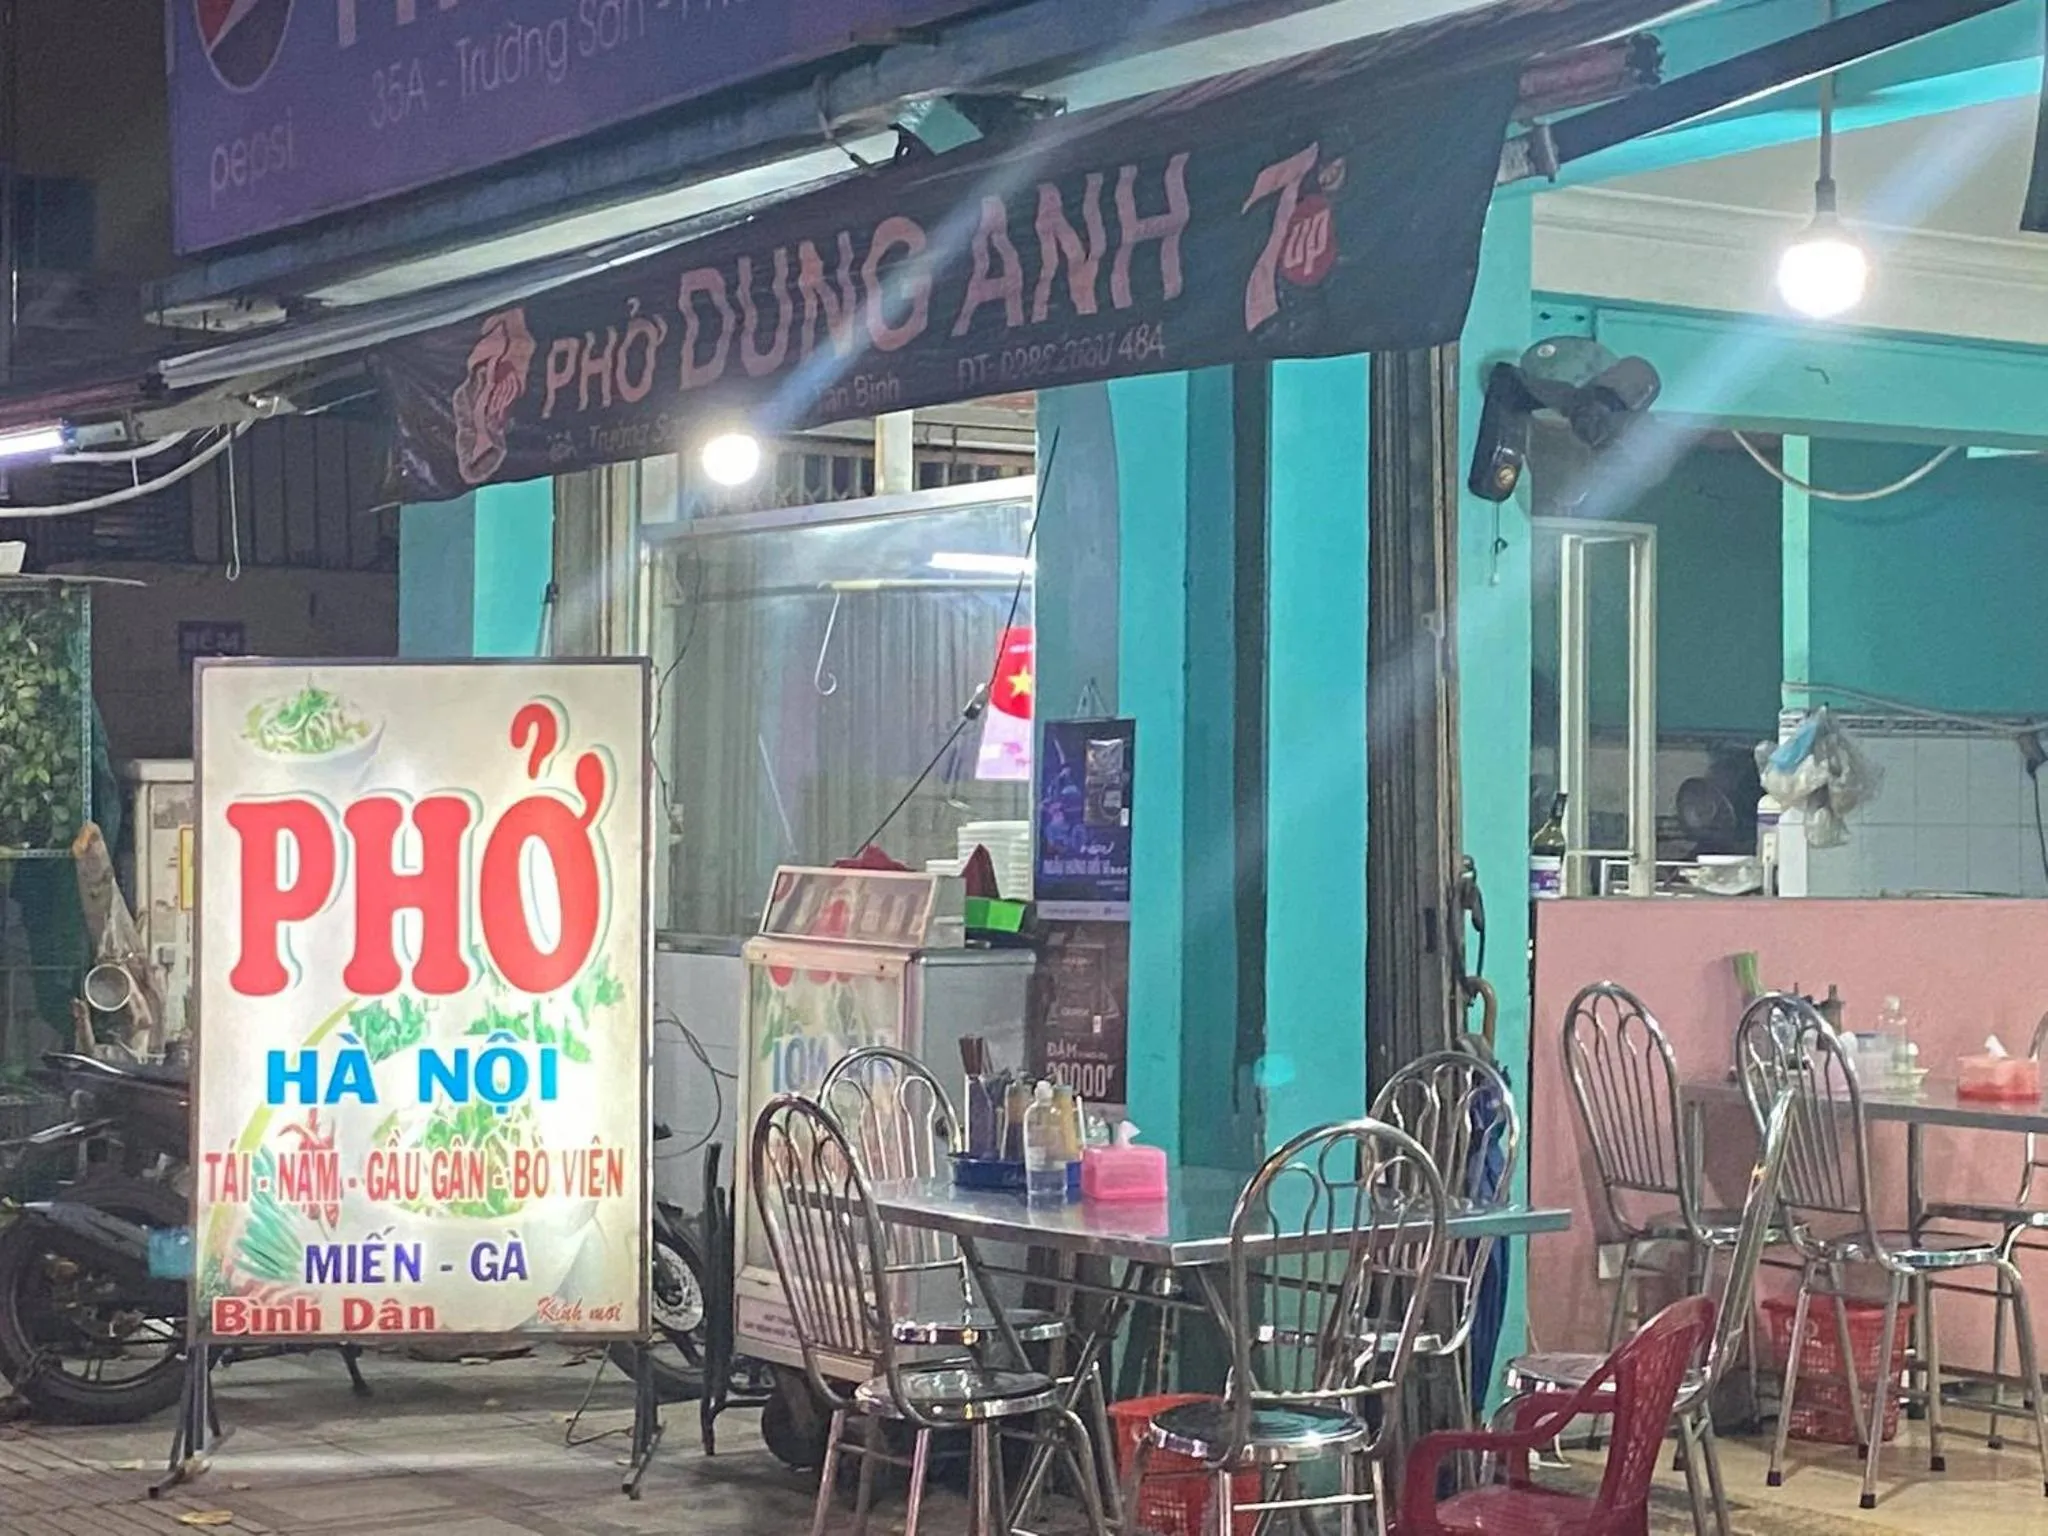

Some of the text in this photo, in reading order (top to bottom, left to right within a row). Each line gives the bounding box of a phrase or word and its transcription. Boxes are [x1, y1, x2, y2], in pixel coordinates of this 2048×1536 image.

[370, 57, 428, 129] 35A
[209, 107, 296, 207] pepsi
[541, 152, 1190, 419] PHỞ DUNG ANH
[1118, 322, 1166, 361] 484
[226, 701, 606, 997] PHỞ
[267, 1031, 557, 1114] HÀ NỘI
[205, 1139, 250, 1202] TÁI
[367, 1129, 420, 1201] GẦU
[431, 1137, 485, 1200] GÂN
[514, 1135, 549, 1198] BÒ
[563, 1136, 624, 1198] VIÊN
[305, 1226, 528, 1283] MIẾN GÀ
[215, 1297, 435, 1332] Bình Dân
